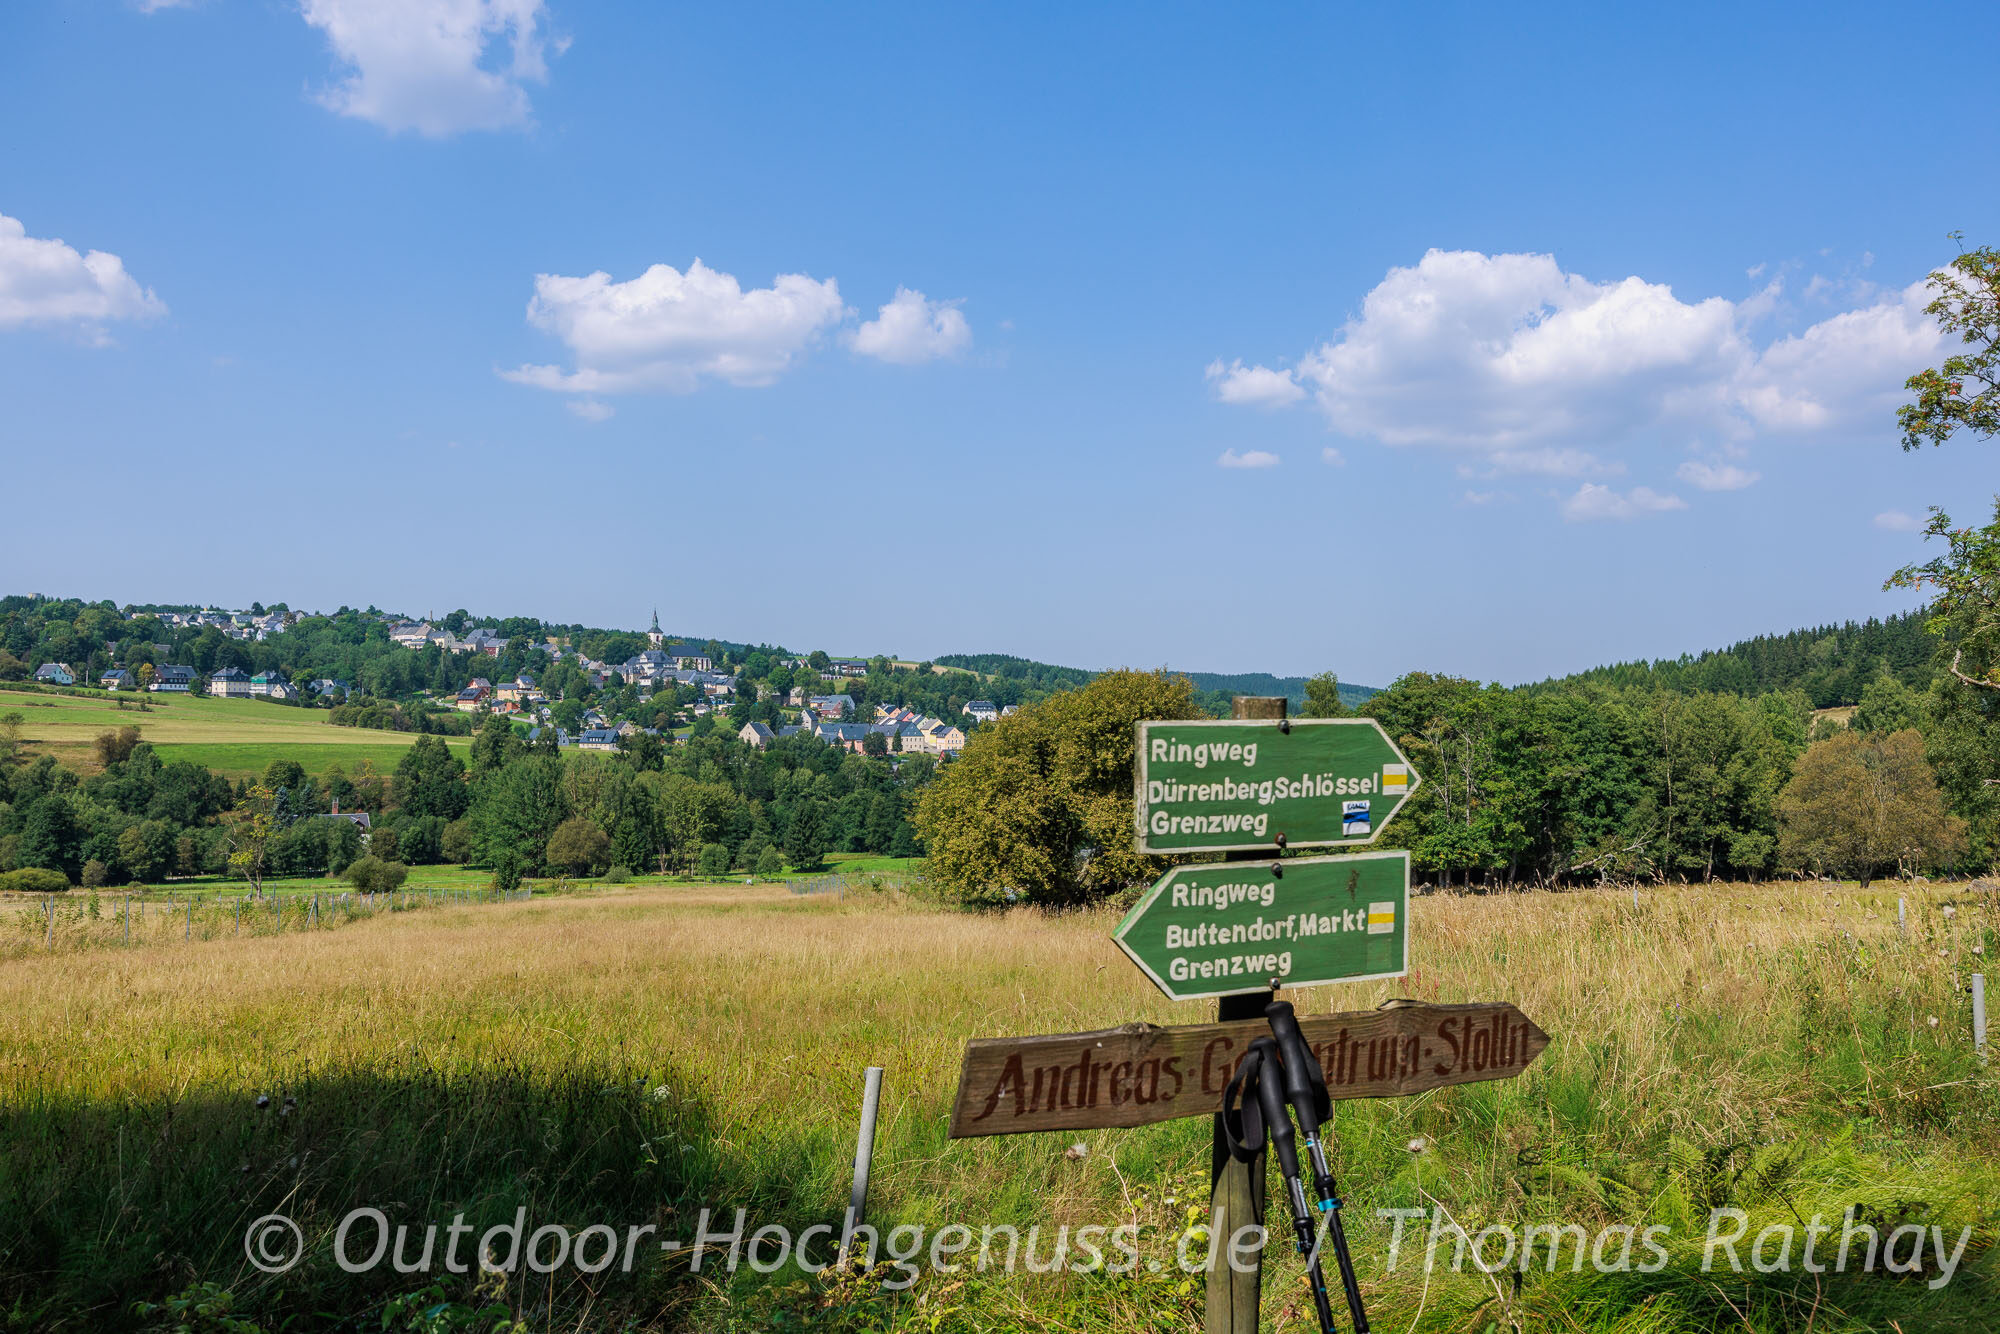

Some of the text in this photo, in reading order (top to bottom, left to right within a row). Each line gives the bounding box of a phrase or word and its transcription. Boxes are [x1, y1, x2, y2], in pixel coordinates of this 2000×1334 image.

[1152, 737, 1258, 767] Ringweg
[1151, 811, 1269, 837] Grenzweg
[1172, 882, 1275, 910] Ringweg
[1169, 951, 1292, 982] Grenzweg
